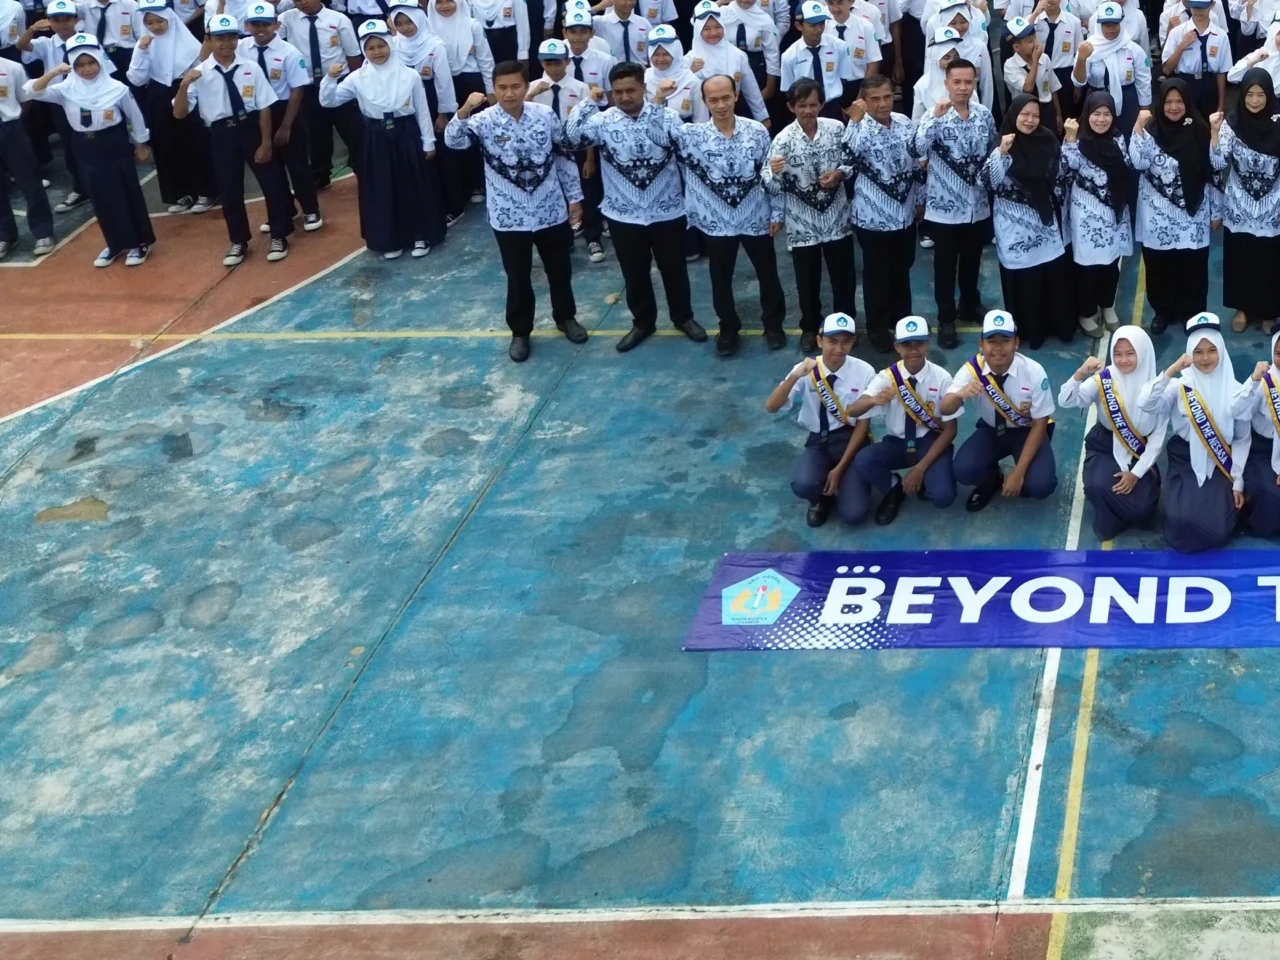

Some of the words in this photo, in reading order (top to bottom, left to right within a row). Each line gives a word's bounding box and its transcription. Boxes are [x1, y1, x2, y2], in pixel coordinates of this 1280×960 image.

[816, 380, 838, 414] BEYOND
[898, 385, 920, 413] BEYOND
[985, 384, 1011, 412] BEYOND
[1102, 378, 1119, 411] BEYOND
[1112, 412, 1126, 429] THE
[1120, 427, 1142, 452] NESASA
[1186, 390, 1207, 424] BEYOND
[1199, 421, 1215, 439] THE
[1207, 436, 1229, 465] NESASA
[820, 574, 1231, 624] BEYOND
